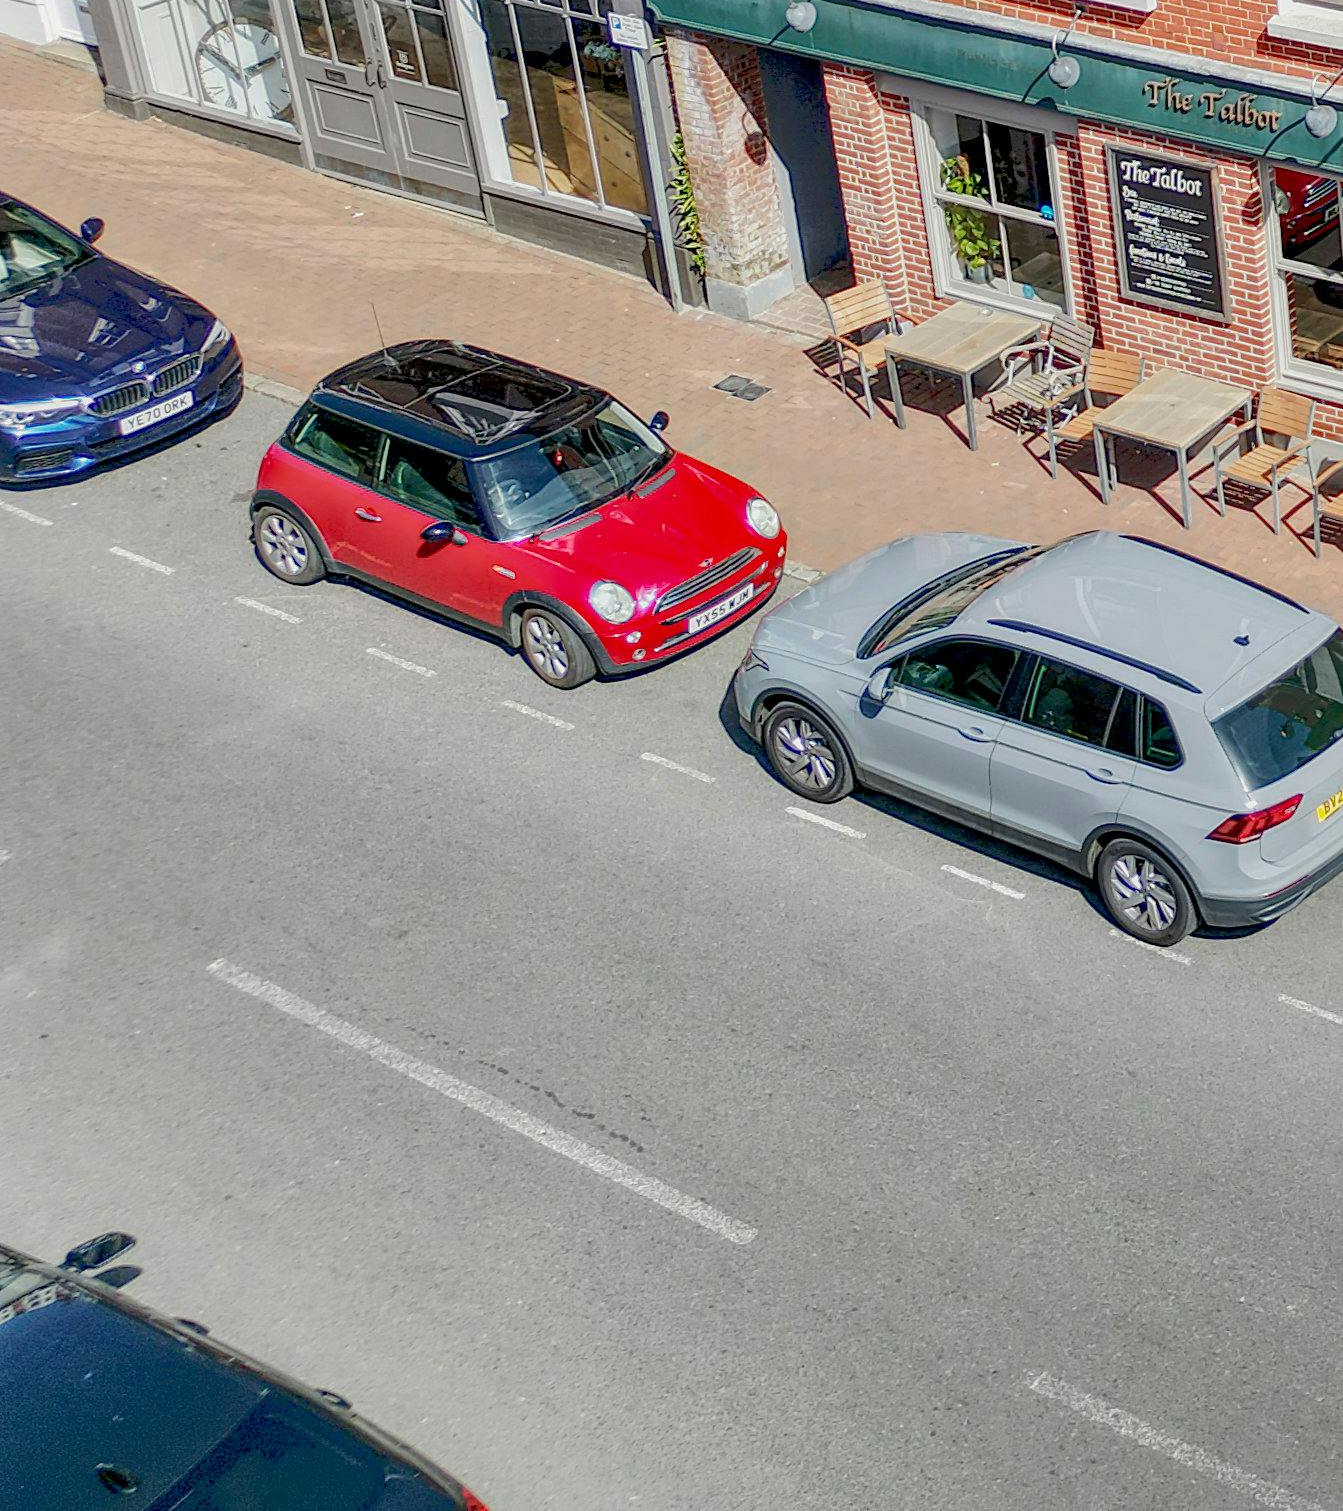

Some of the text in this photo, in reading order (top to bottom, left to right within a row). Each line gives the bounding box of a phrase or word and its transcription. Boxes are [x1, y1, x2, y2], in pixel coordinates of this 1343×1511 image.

[1143, 76, 1283, 132] The Talbot
[1120, 159, 1204, 197] The Talbot
[128, 395, 188, 429] YE70 ORK
